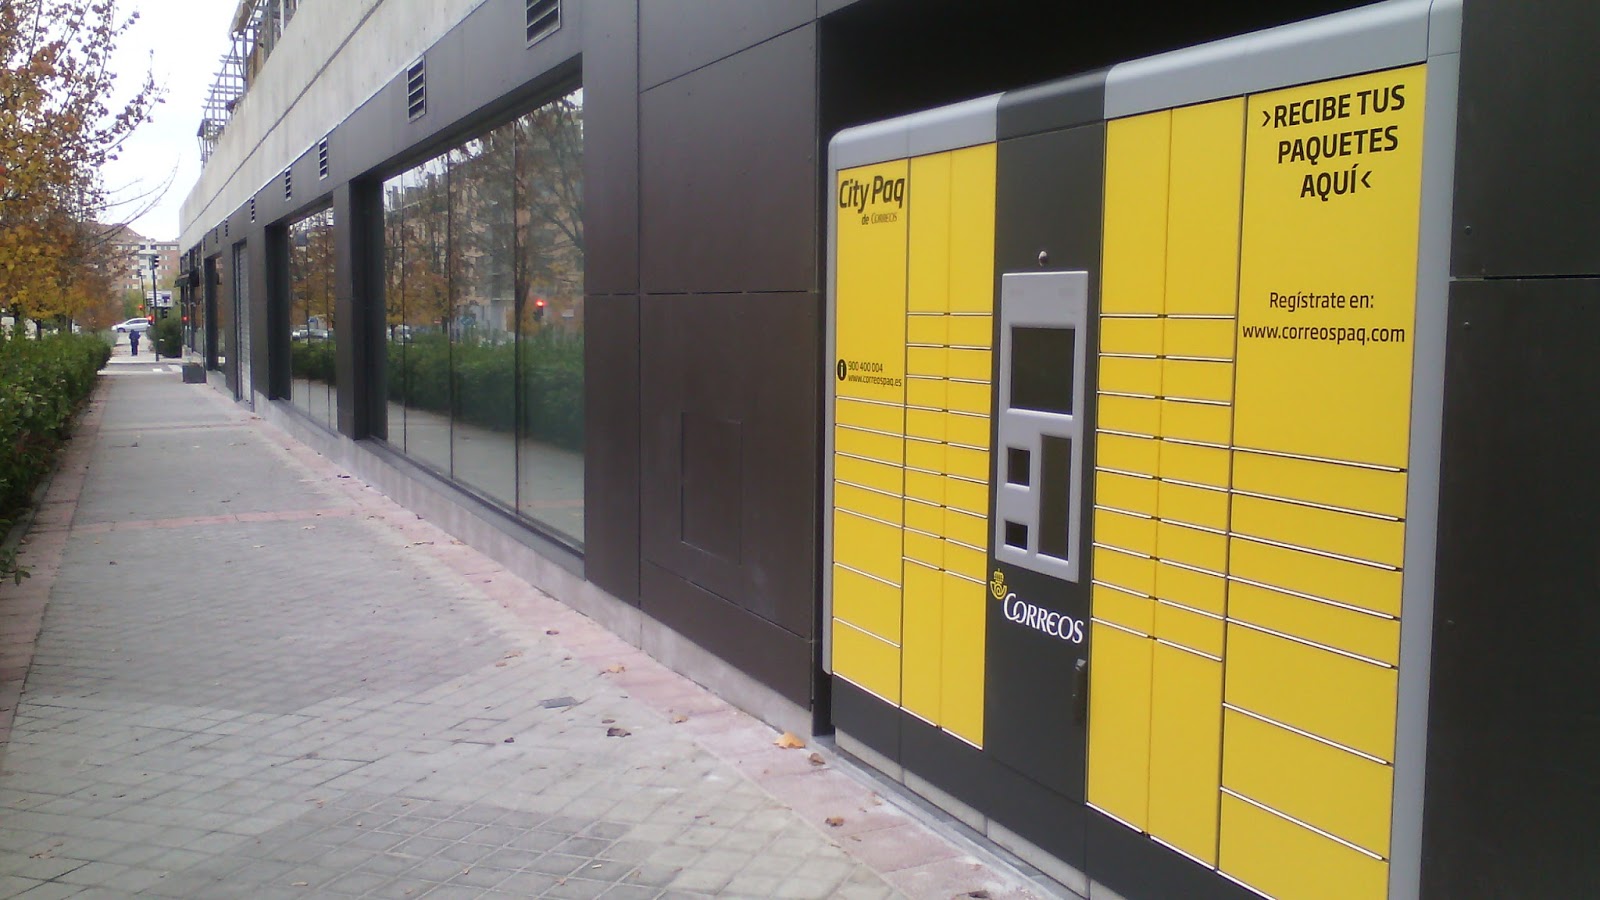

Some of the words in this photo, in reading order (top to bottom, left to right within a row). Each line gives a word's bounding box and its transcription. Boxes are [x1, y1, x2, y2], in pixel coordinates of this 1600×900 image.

[1357, 84, 1405, 116] TUS
[1278, 125, 1398, 165] PAQUETES
[861, 214, 870, 225] de
[1269, 291, 1346, 313] Regístrate
[1349, 294, 1374, 309] en:
[1242, 325, 1406, 346] www.correospaq.com
[859, 362, 870, 372] 400
[871, 363, 883, 373] 004
[848, 374, 902, 387] www.correospaq.es
[1003, 592, 1084, 644] CORREOS
